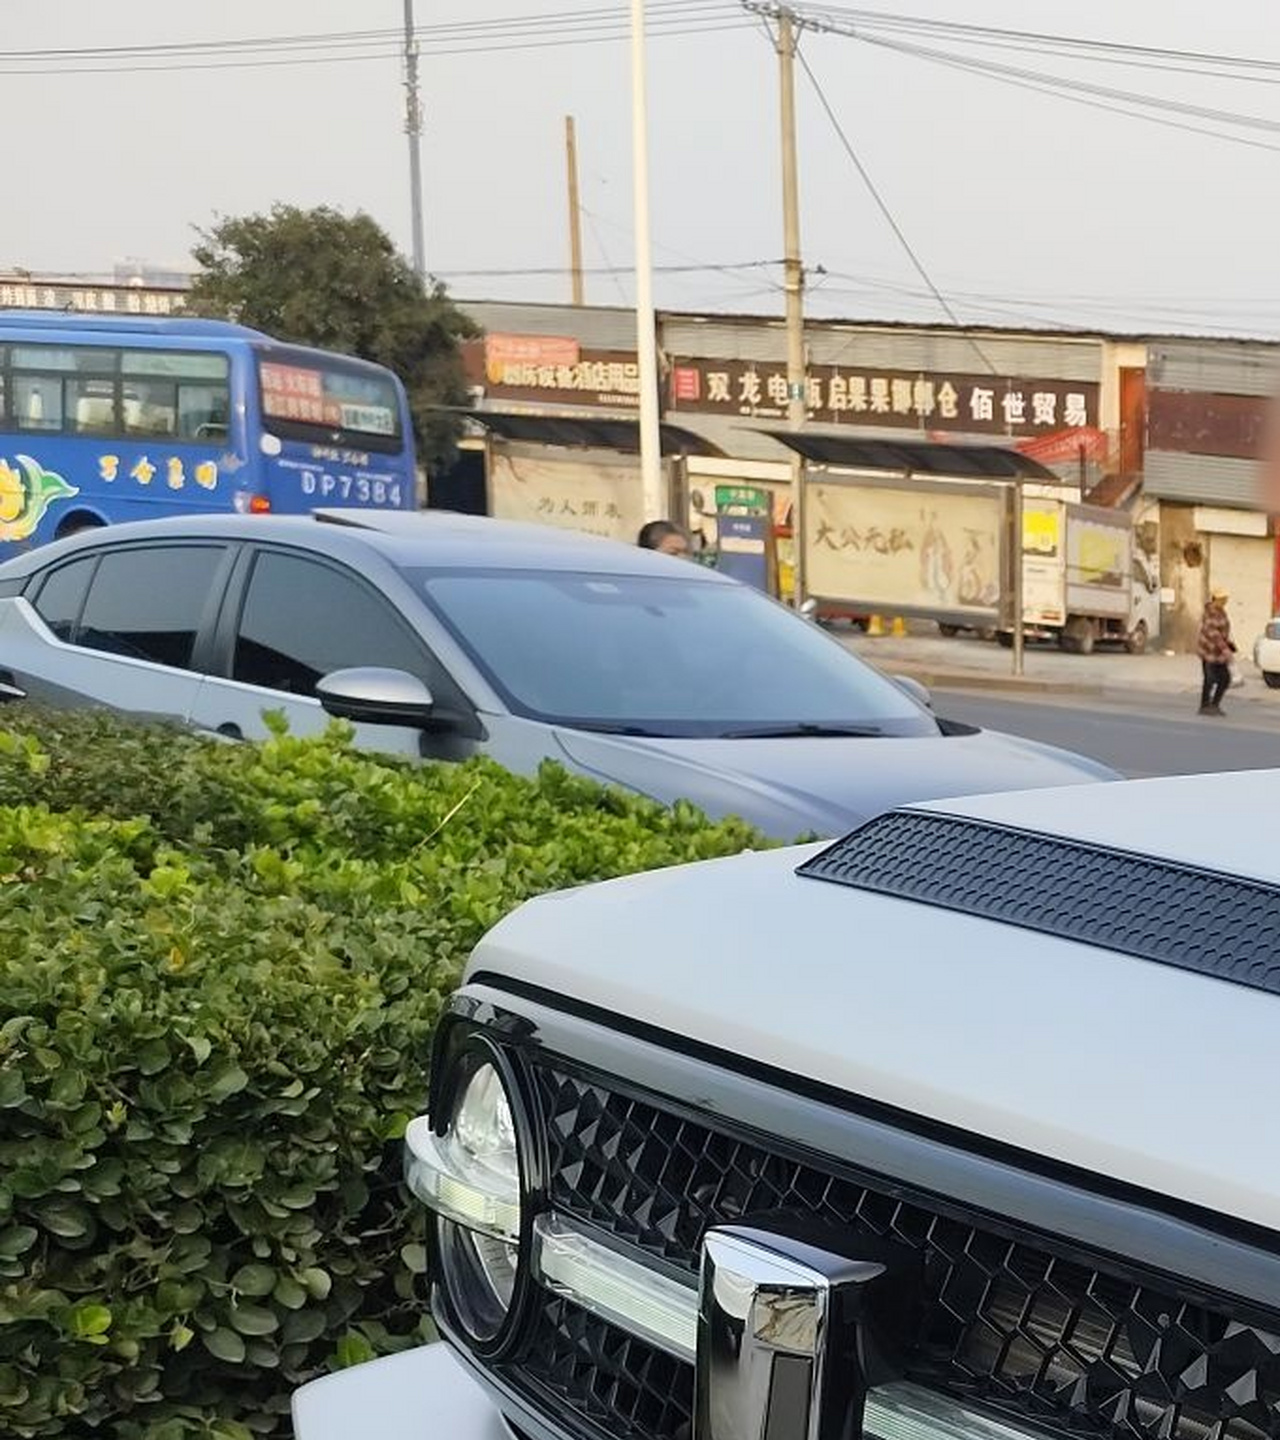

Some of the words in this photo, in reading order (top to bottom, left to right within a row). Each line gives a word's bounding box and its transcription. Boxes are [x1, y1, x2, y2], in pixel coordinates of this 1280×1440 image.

[970, 387, 1087, 427] 佰世贸易
[302, 471, 401, 506] DP7384
[813, 519, 914, 556] 大公无私
